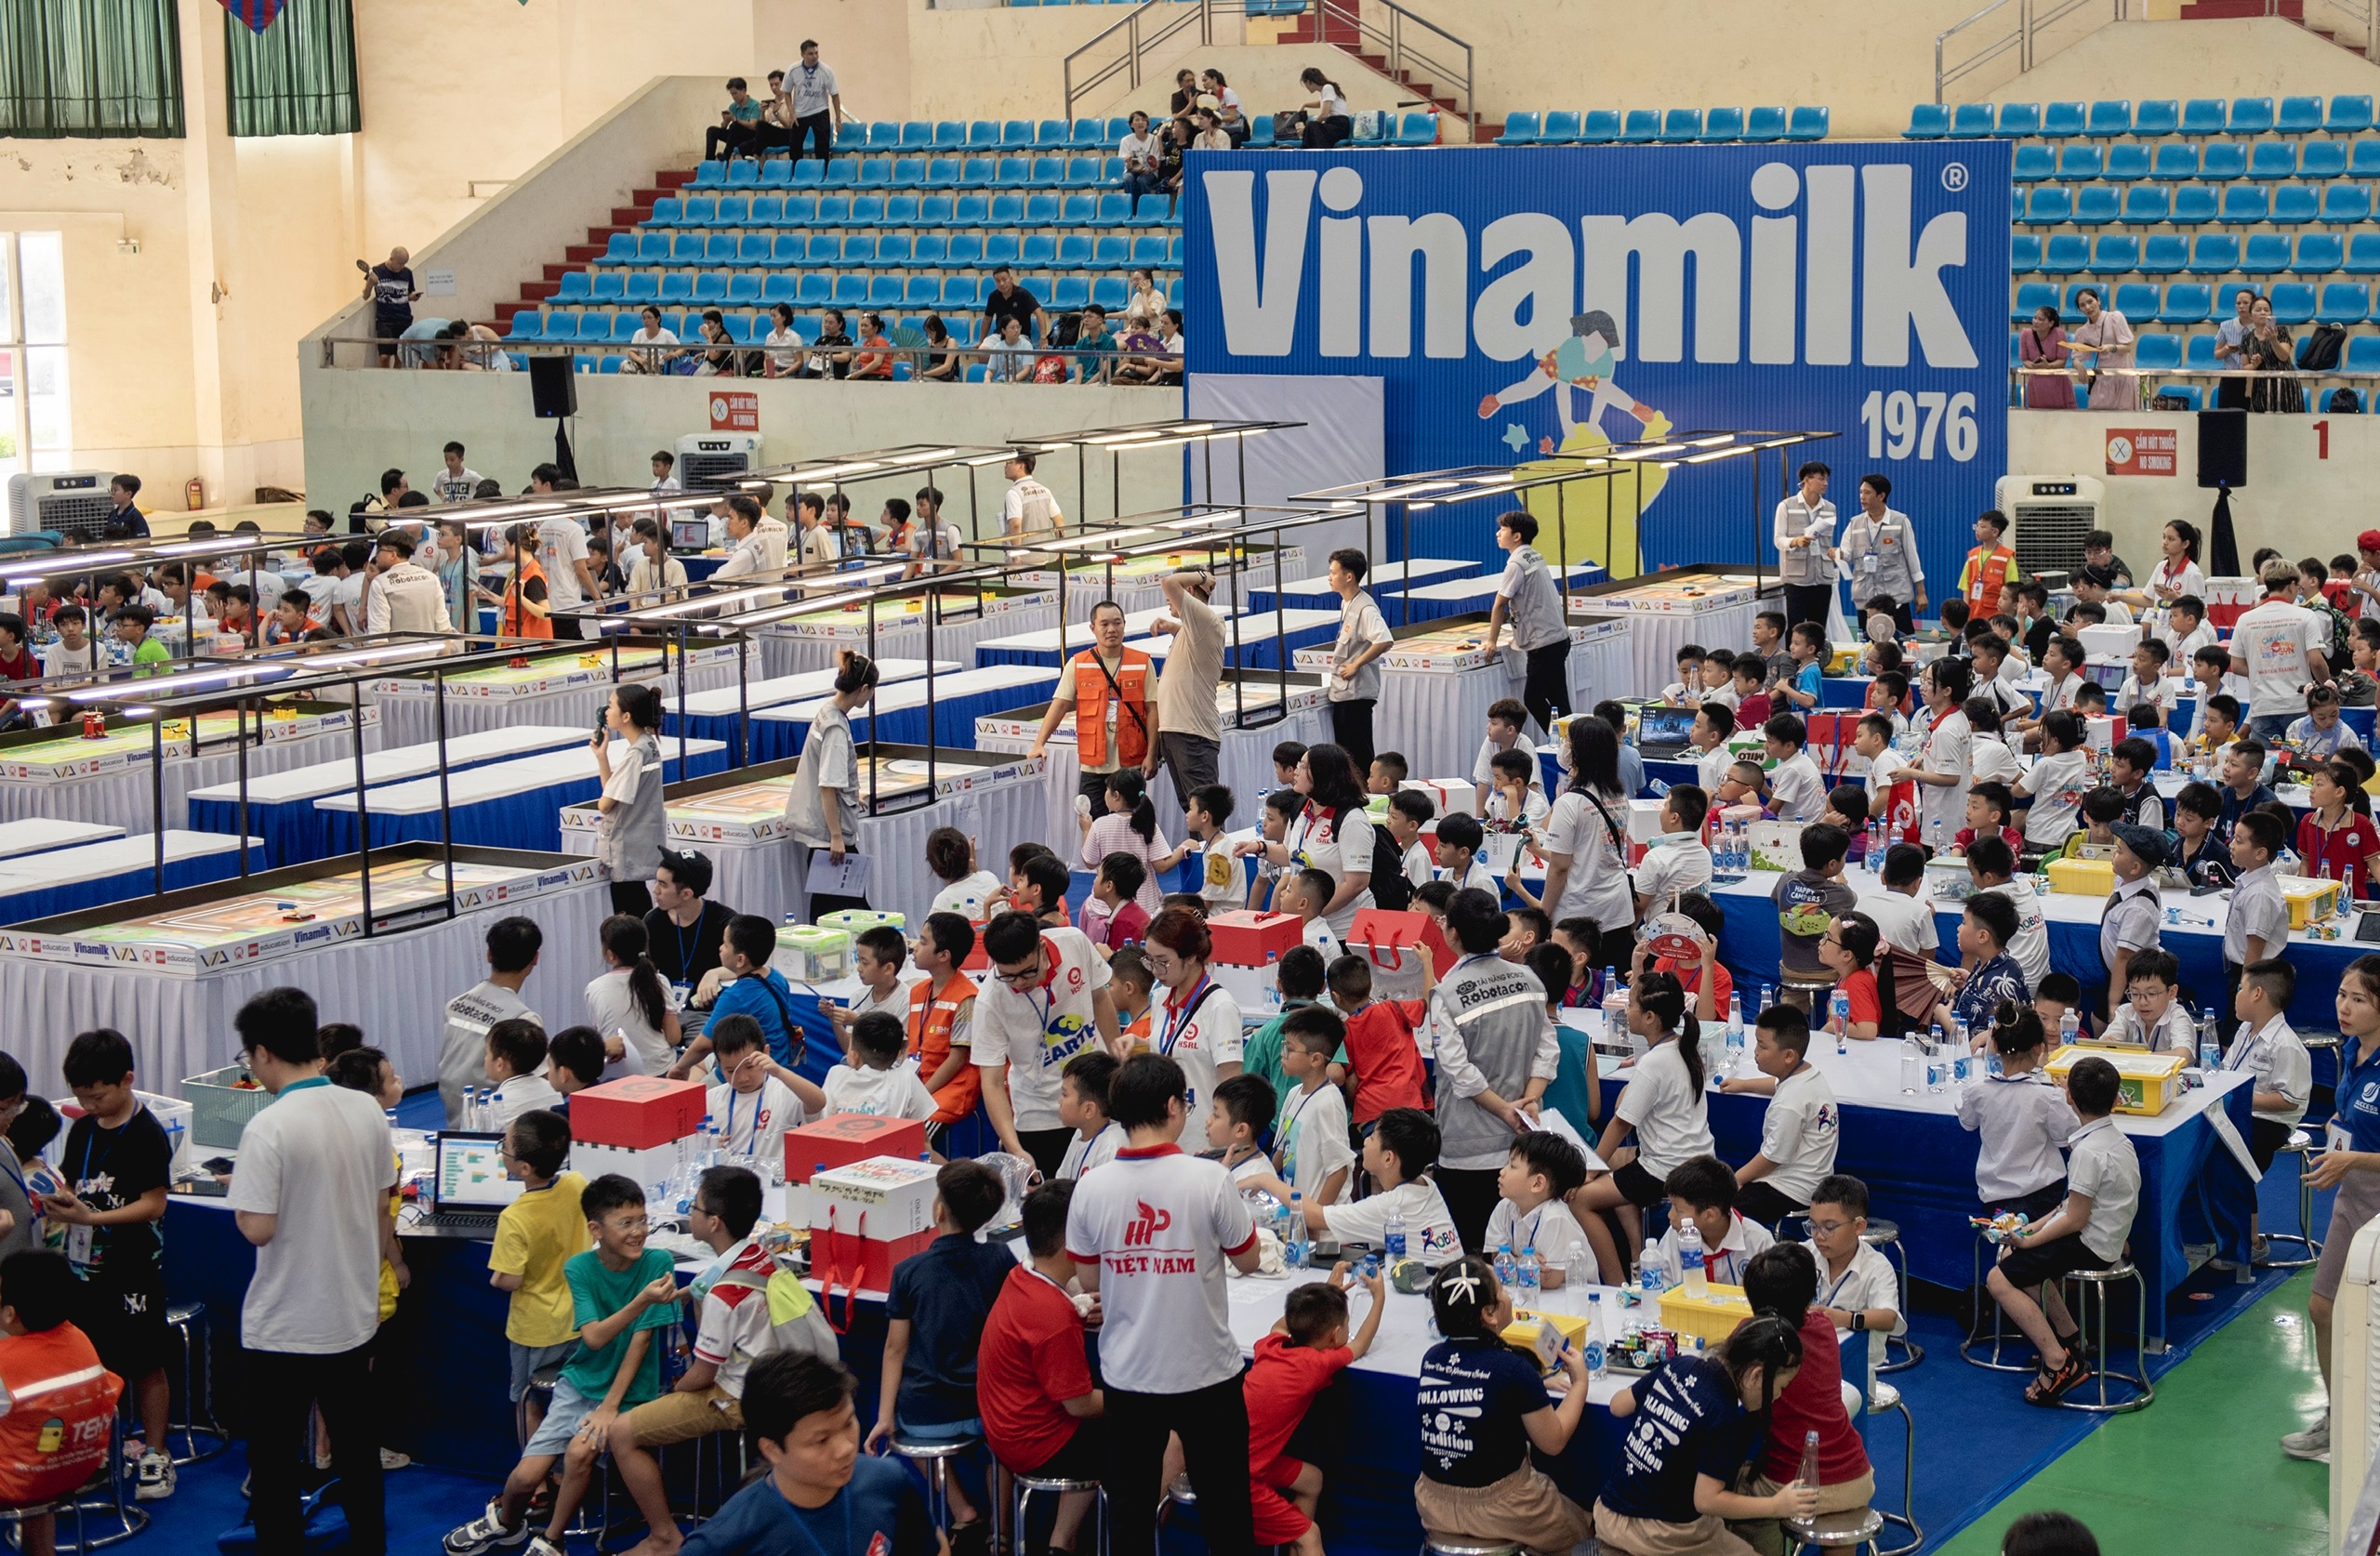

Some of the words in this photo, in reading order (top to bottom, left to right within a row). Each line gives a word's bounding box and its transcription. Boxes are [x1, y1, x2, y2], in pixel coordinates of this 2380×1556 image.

[1202, 162, 1981, 370] Vinamilk
[738, 415, 756, 427] SMOKING
[1860, 389, 1979, 463] 1976
[2312, 420, 2329, 460] 1
[2139, 455, 2148, 469] NO
[2148, 456, 2172, 470] SMOKING
[389, 574, 430, 587] Robotacon
[1606, 599, 1631, 608] Vinamilk
[774, 623, 798, 632] Vinamilk
[566, 675, 589, 685] Vinamilk
[321, 714, 346, 727] Vinamilk
[1738, 752, 1765, 761] MILO
[993, 767, 1017, 781] Vinamilk
[722, 829, 748, 837] education
[508, 881, 535, 894] education
[537, 870, 569, 888] Vinamilk
[1791, 891, 1820, 903] CAMPERS
[1794, 885, 1816, 896] HAPPY
[259, 939, 291, 953] education
[294, 925, 331, 944] Vinamilk
[42, 942, 71, 955] education
[73, 942, 109, 956] Vinamilk
[167, 954, 196, 963] education
[1476, 976, 1488, 986] TÀI
[1488, 973, 1506, 984] NĂNG
[1506, 971, 1525, 981] ROBOT
[1460, 982, 1531, 1009] Robotacon
[1043, 1021, 1095, 1068] EARTH
[1178, 1040, 1198, 1050] HSRL
[1104, 1254, 1149, 1277] VIỆT
[1153, 1257, 1196, 1274] NAM
[1417, 1388, 1484, 1405] FOLLOWING
